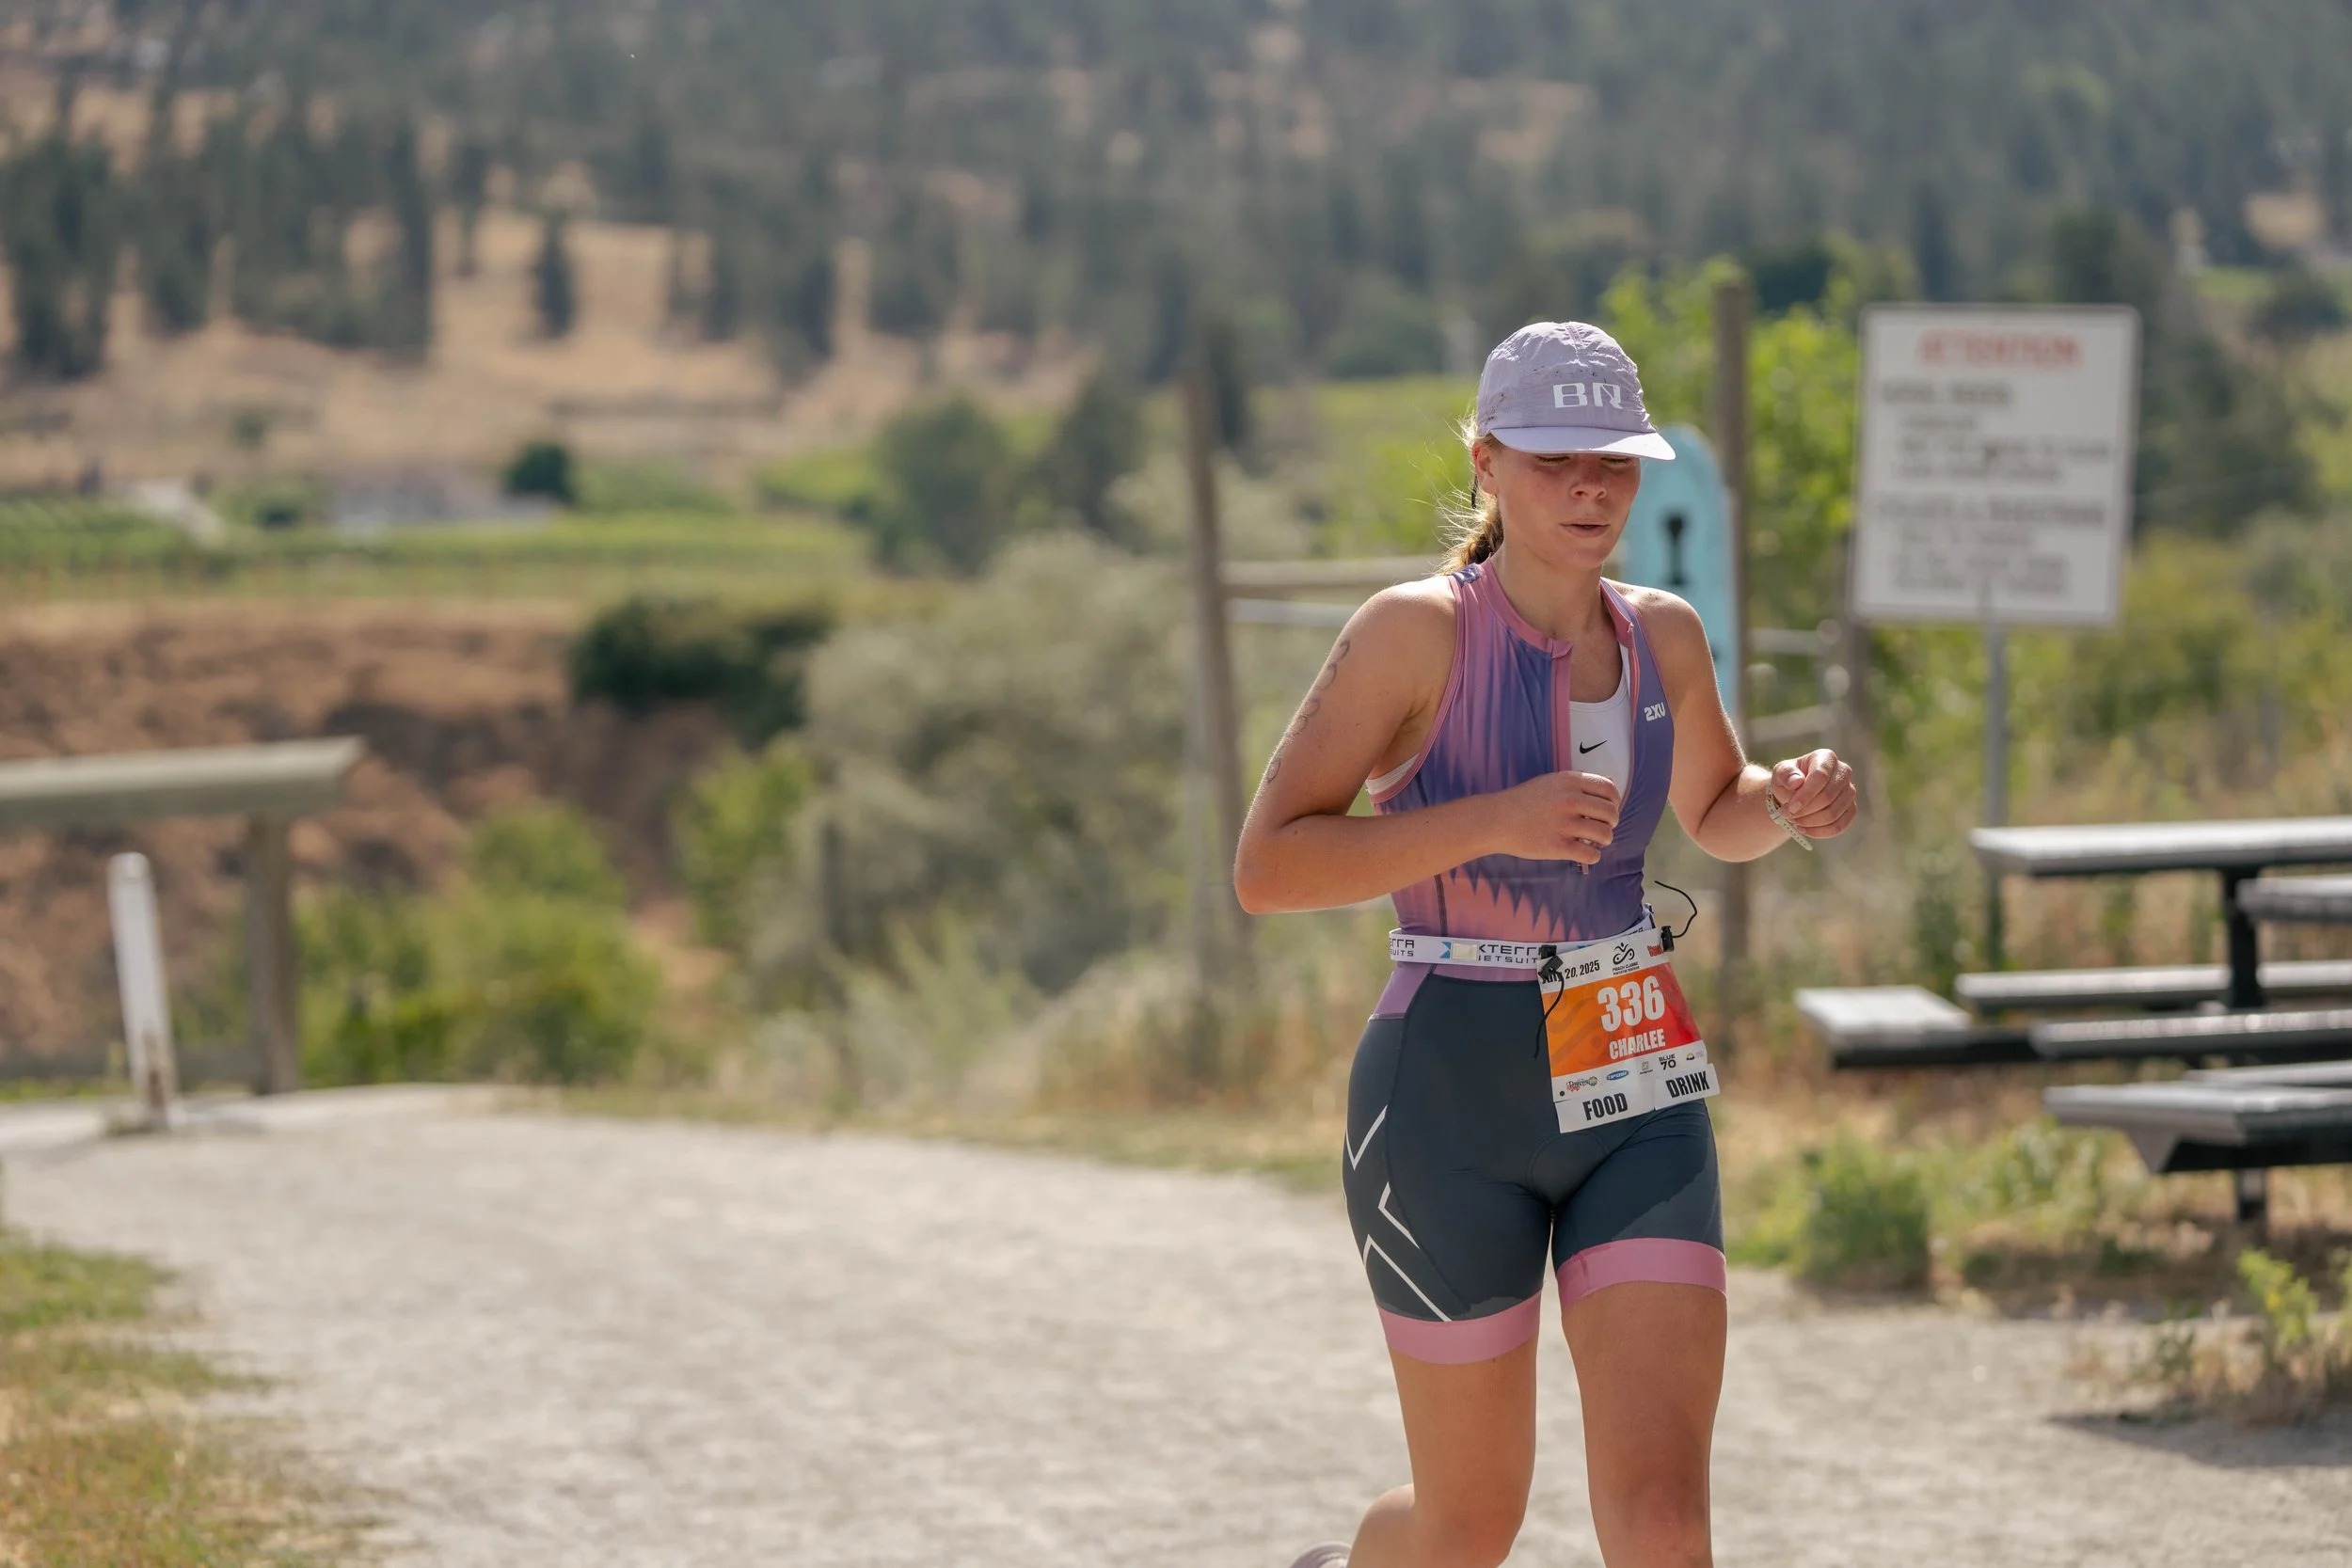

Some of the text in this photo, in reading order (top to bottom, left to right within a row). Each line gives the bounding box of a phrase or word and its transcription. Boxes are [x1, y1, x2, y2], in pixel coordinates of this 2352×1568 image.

[1553, 382, 1624, 409] BR
[1644, 702, 1666, 721] 2XU
[1565, 967, 1579, 979] 20,
[1580, 959, 1600, 976] 2025
[1597, 975, 1665, 1032] 336
[1609, 1028, 1666, 1060] CHARLEE
[1659, 1053, 1676, 1062] BLUE
[1660, 1059, 1677, 1070] 70
[1665, 1070, 1710, 1099] DRINK
[1582, 1092, 1629, 1120] FOOD
